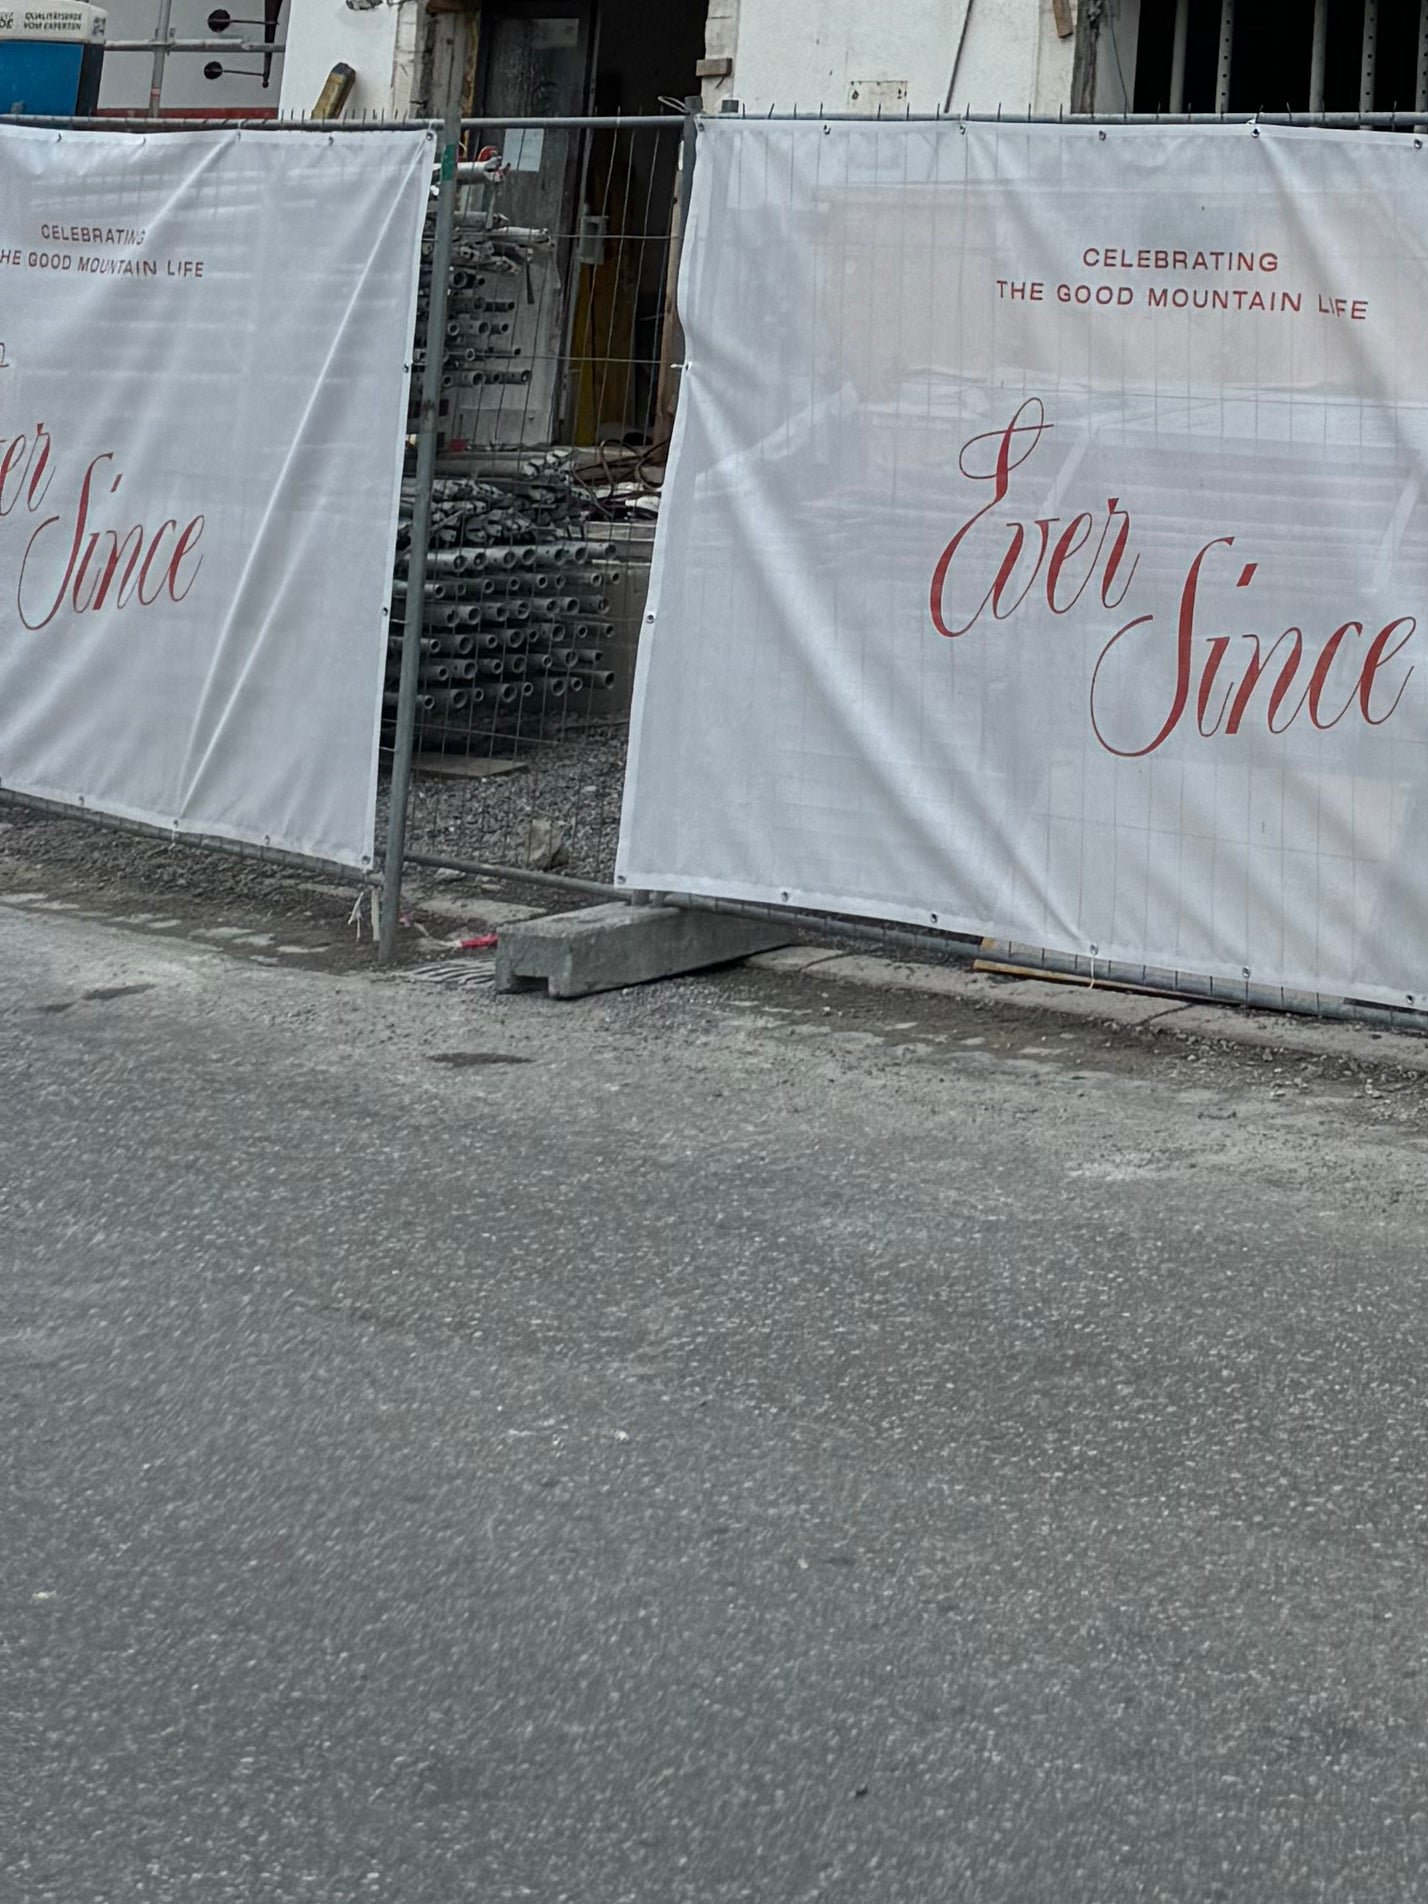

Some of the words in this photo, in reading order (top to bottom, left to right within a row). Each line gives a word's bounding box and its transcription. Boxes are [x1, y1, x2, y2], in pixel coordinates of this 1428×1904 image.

[41, 224, 146, 245] CELEBRATING
[28, 252, 71, 271] GOOD
[77, 256, 157, 276] MOUNTAIN
[167, 260, 204, 277] LIFE
[1083, 247, 1279, 272] CELEBRATING
[996, 280, 1043, 301] THE
[1056, 284, 1134, 307] GOOD
[1147, 288, 1302, 313] MOUNTAIN
[1317, 294, 1369, 320] LIFE
[930, 397, 1140, 638] Ever
[18, 452, 205, 630] Since
[1090, 536, 1417, 757] Since
